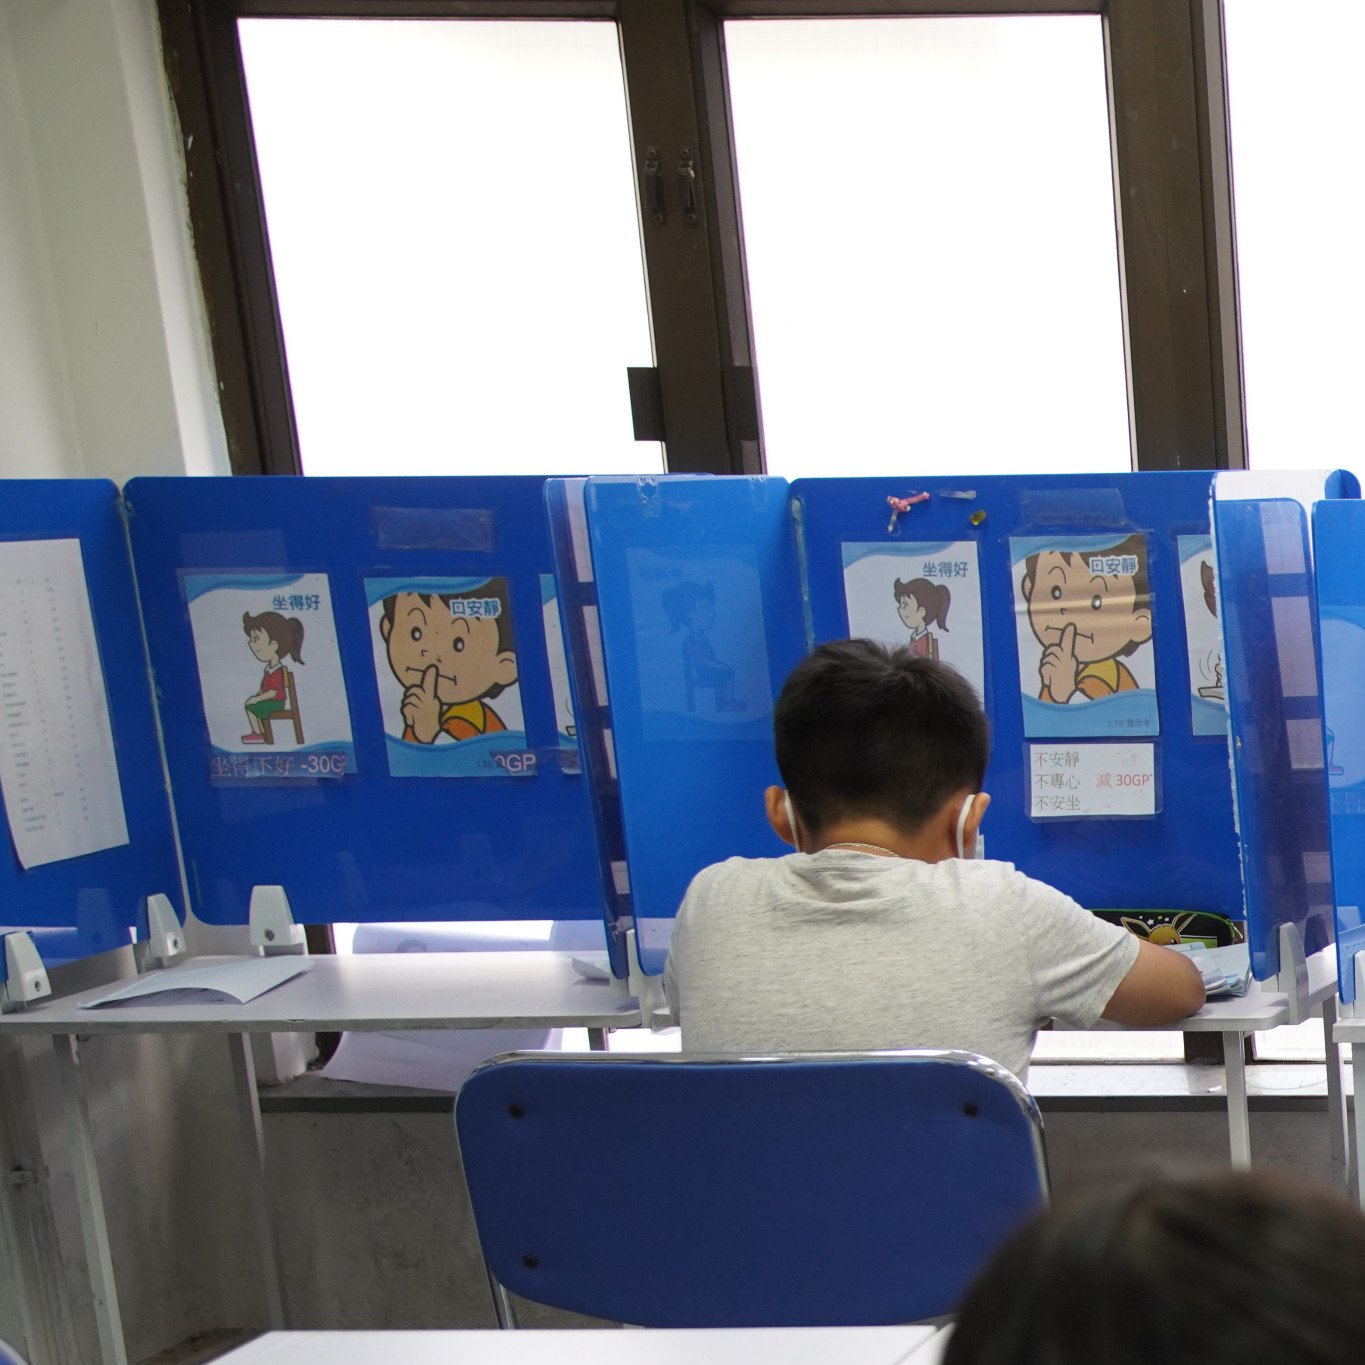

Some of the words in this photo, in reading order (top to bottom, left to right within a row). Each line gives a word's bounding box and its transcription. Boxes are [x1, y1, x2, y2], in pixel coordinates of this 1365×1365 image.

[922, 561, 969, 579] 坐得好
[1089, 556, 1138, 575] 口安靜
[272, 595, 321, 611] 坐得好
[451, 599, 500, 617] 口安靜
[1034, 751, 1080, 768] 不安靜
[1034, 773, 1081, 790] 不專心
[1096, 773, 1112, 789] 減
[1116, 774, 1150, 787] 30GP
[1034, 795, 1081, 812] 不安坐
